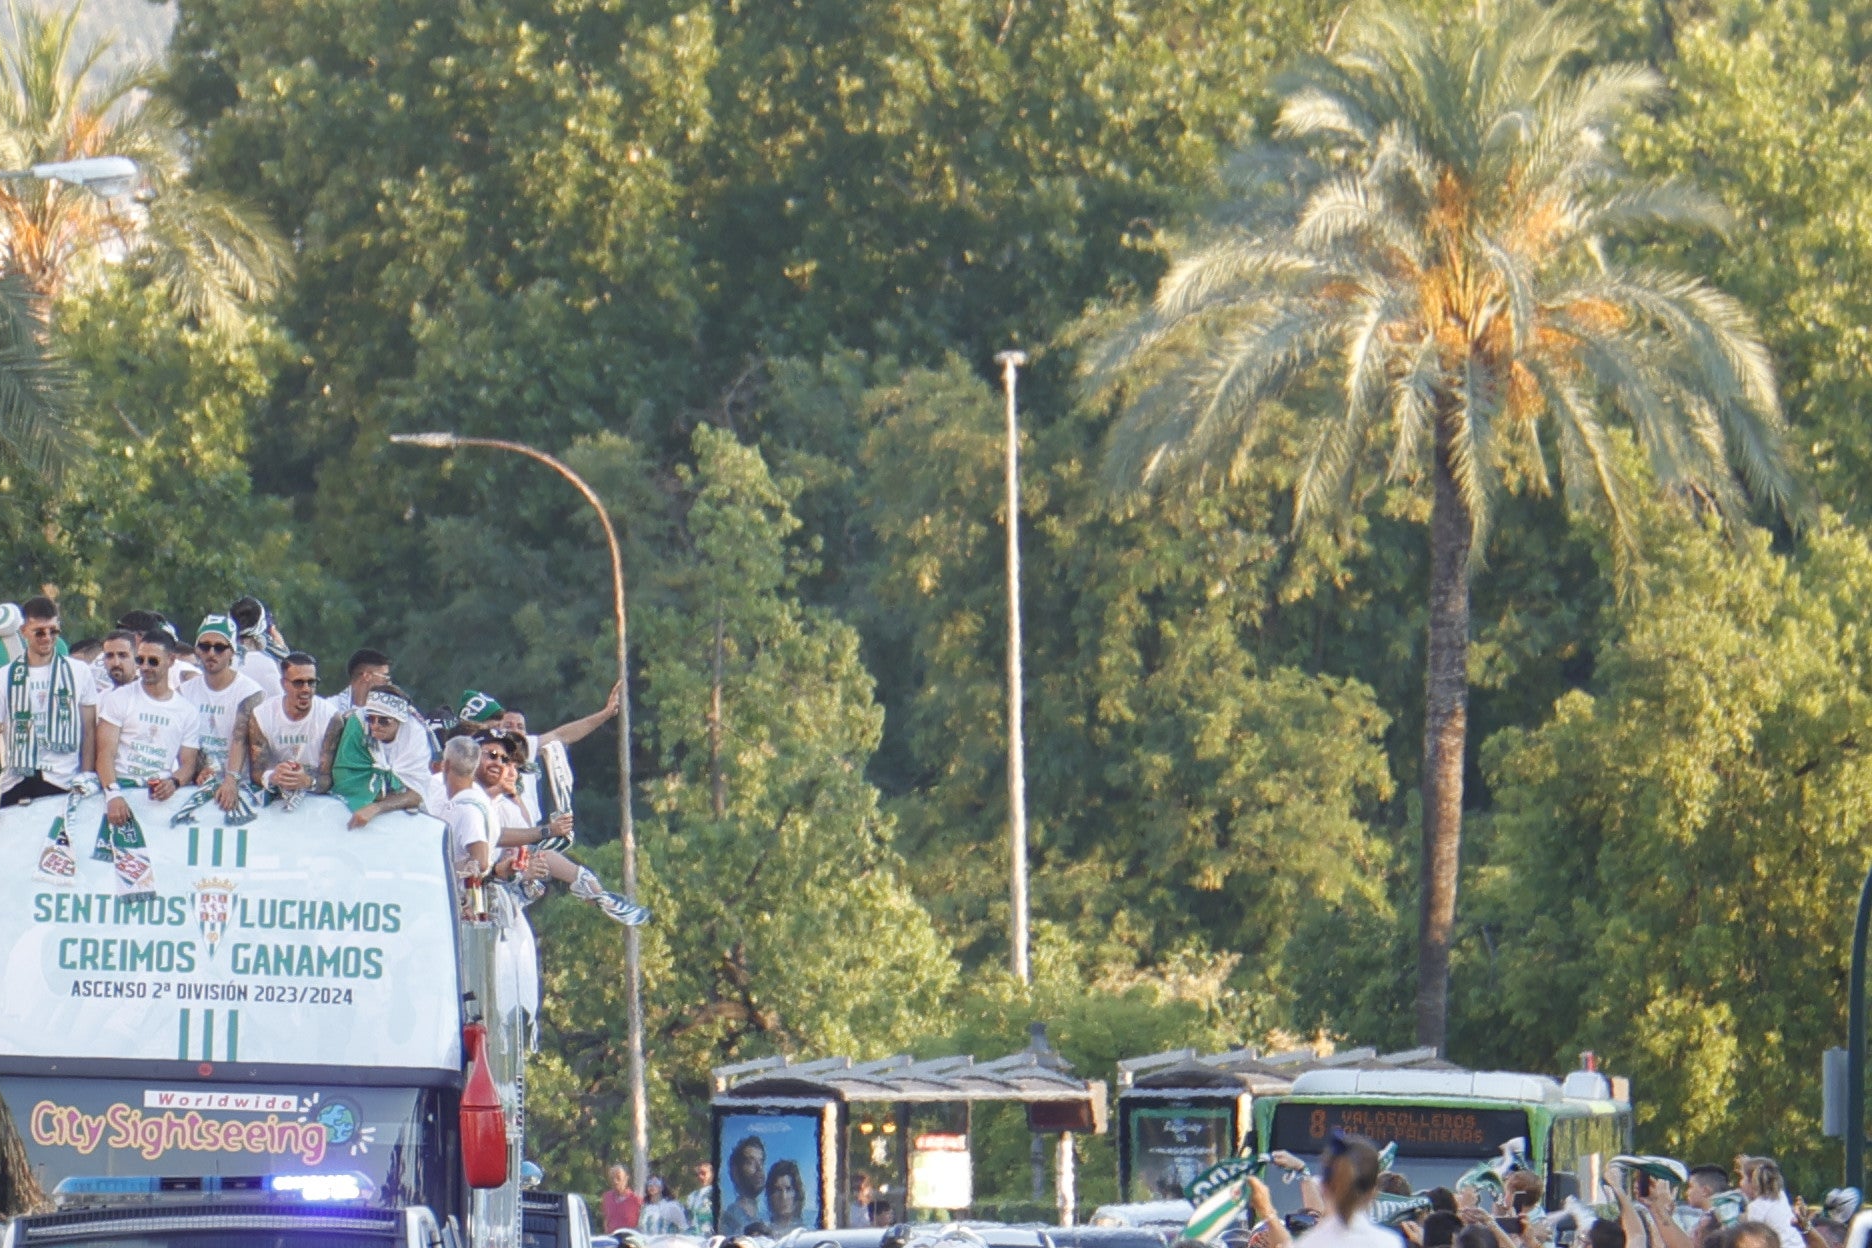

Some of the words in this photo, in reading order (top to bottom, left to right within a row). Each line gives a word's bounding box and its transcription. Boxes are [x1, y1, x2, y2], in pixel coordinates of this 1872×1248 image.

[34, 893, 187, 926] SENTIMOS
[239, 900, 401, 933] LUCHAMOS
[59, 938, 195, 973] CREIMOS
[232, 943, 383, 979] GANAMOS
[71, 980, 147, 999] ASCENSO
[152, 982, 171, 999] 2ª
[177, 979, 248, 1001] DIVISIÓN
[254, 985, 353, 1005] 2023/2024
[159, 1092, 293, 1110] Worldwide
[31, 1100, 106, 1155] City
[107, 1103, 327, 1165] Sightseeing
[1310, 1109, 1326, 1138] 8
